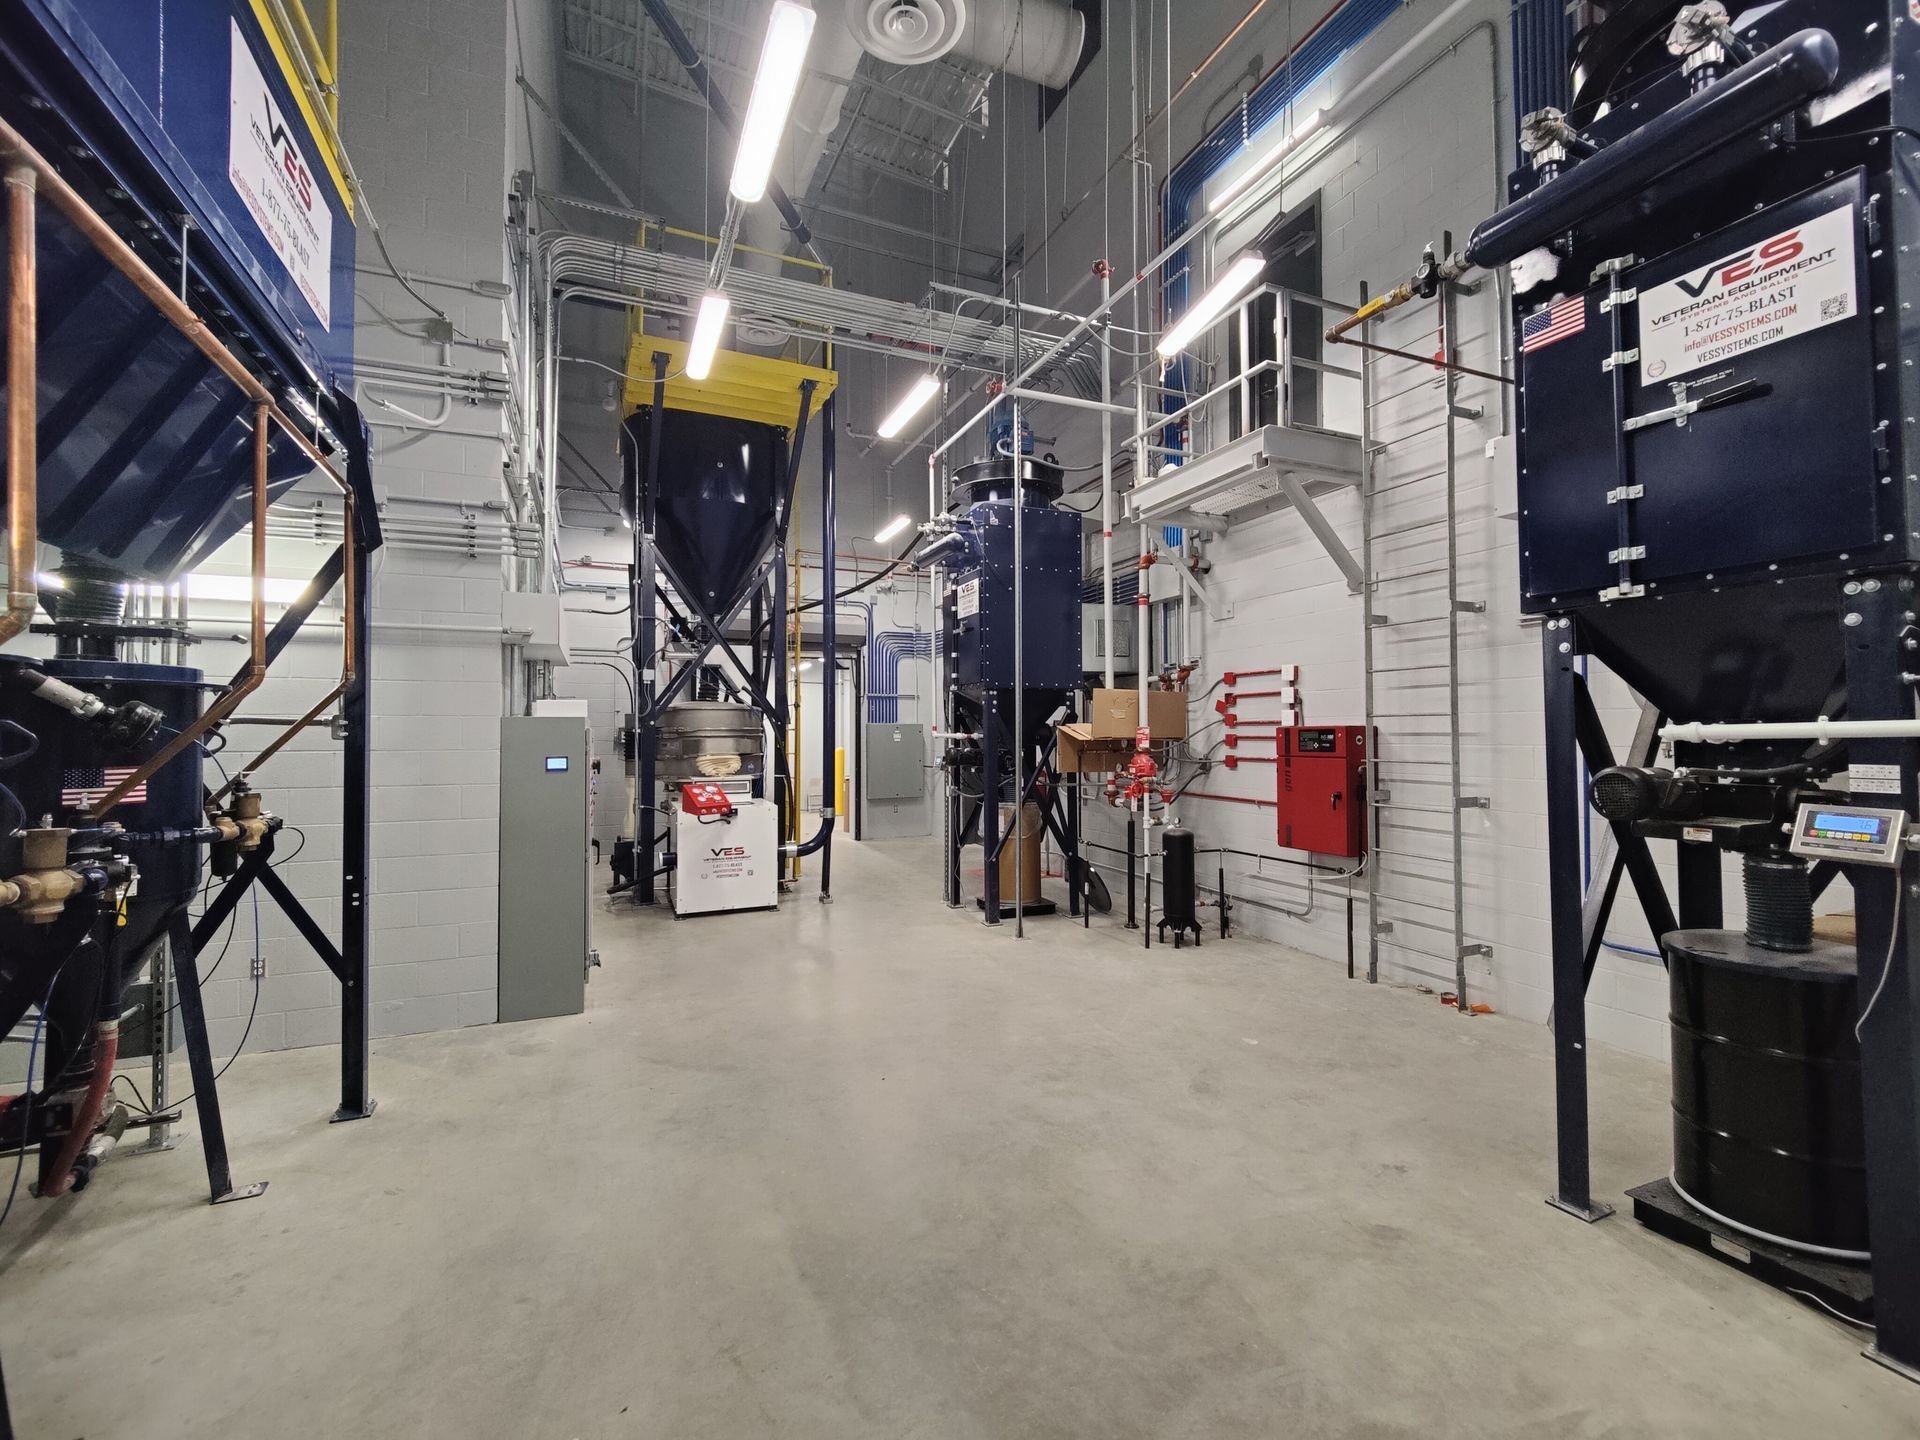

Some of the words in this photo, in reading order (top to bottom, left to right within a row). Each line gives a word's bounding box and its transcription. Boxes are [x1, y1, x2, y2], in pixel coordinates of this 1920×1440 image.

[250, 112, 285, 182] VETERAN
[285, 181, 319, 245] EQUIPMENT
[263, 91, 311, 212] VES
[261, 177, 310, 270] 1-877-75-BLAST
[1651, 292, 1724, 326] VETERAN
[1728, 247, 1836, 298] EQUIPMENT
[1675, 229, 1804, 298] VES
[1680, 299, 1730, 322] SYSTEMS
[1733, 290, 1757, 302] AND
[1760, 273, 1800, 292] SALES
[1683, 284, 1797, 338] 1-877-75-BLAST
[1684, 303, 1798, 353] info@VESSYSTEMS.COM
[1697, 325, 1784, 363] VESSYSTEMS.COM
[961, 581, 975, 594] VES
[711, 847, 744, 857] VES
